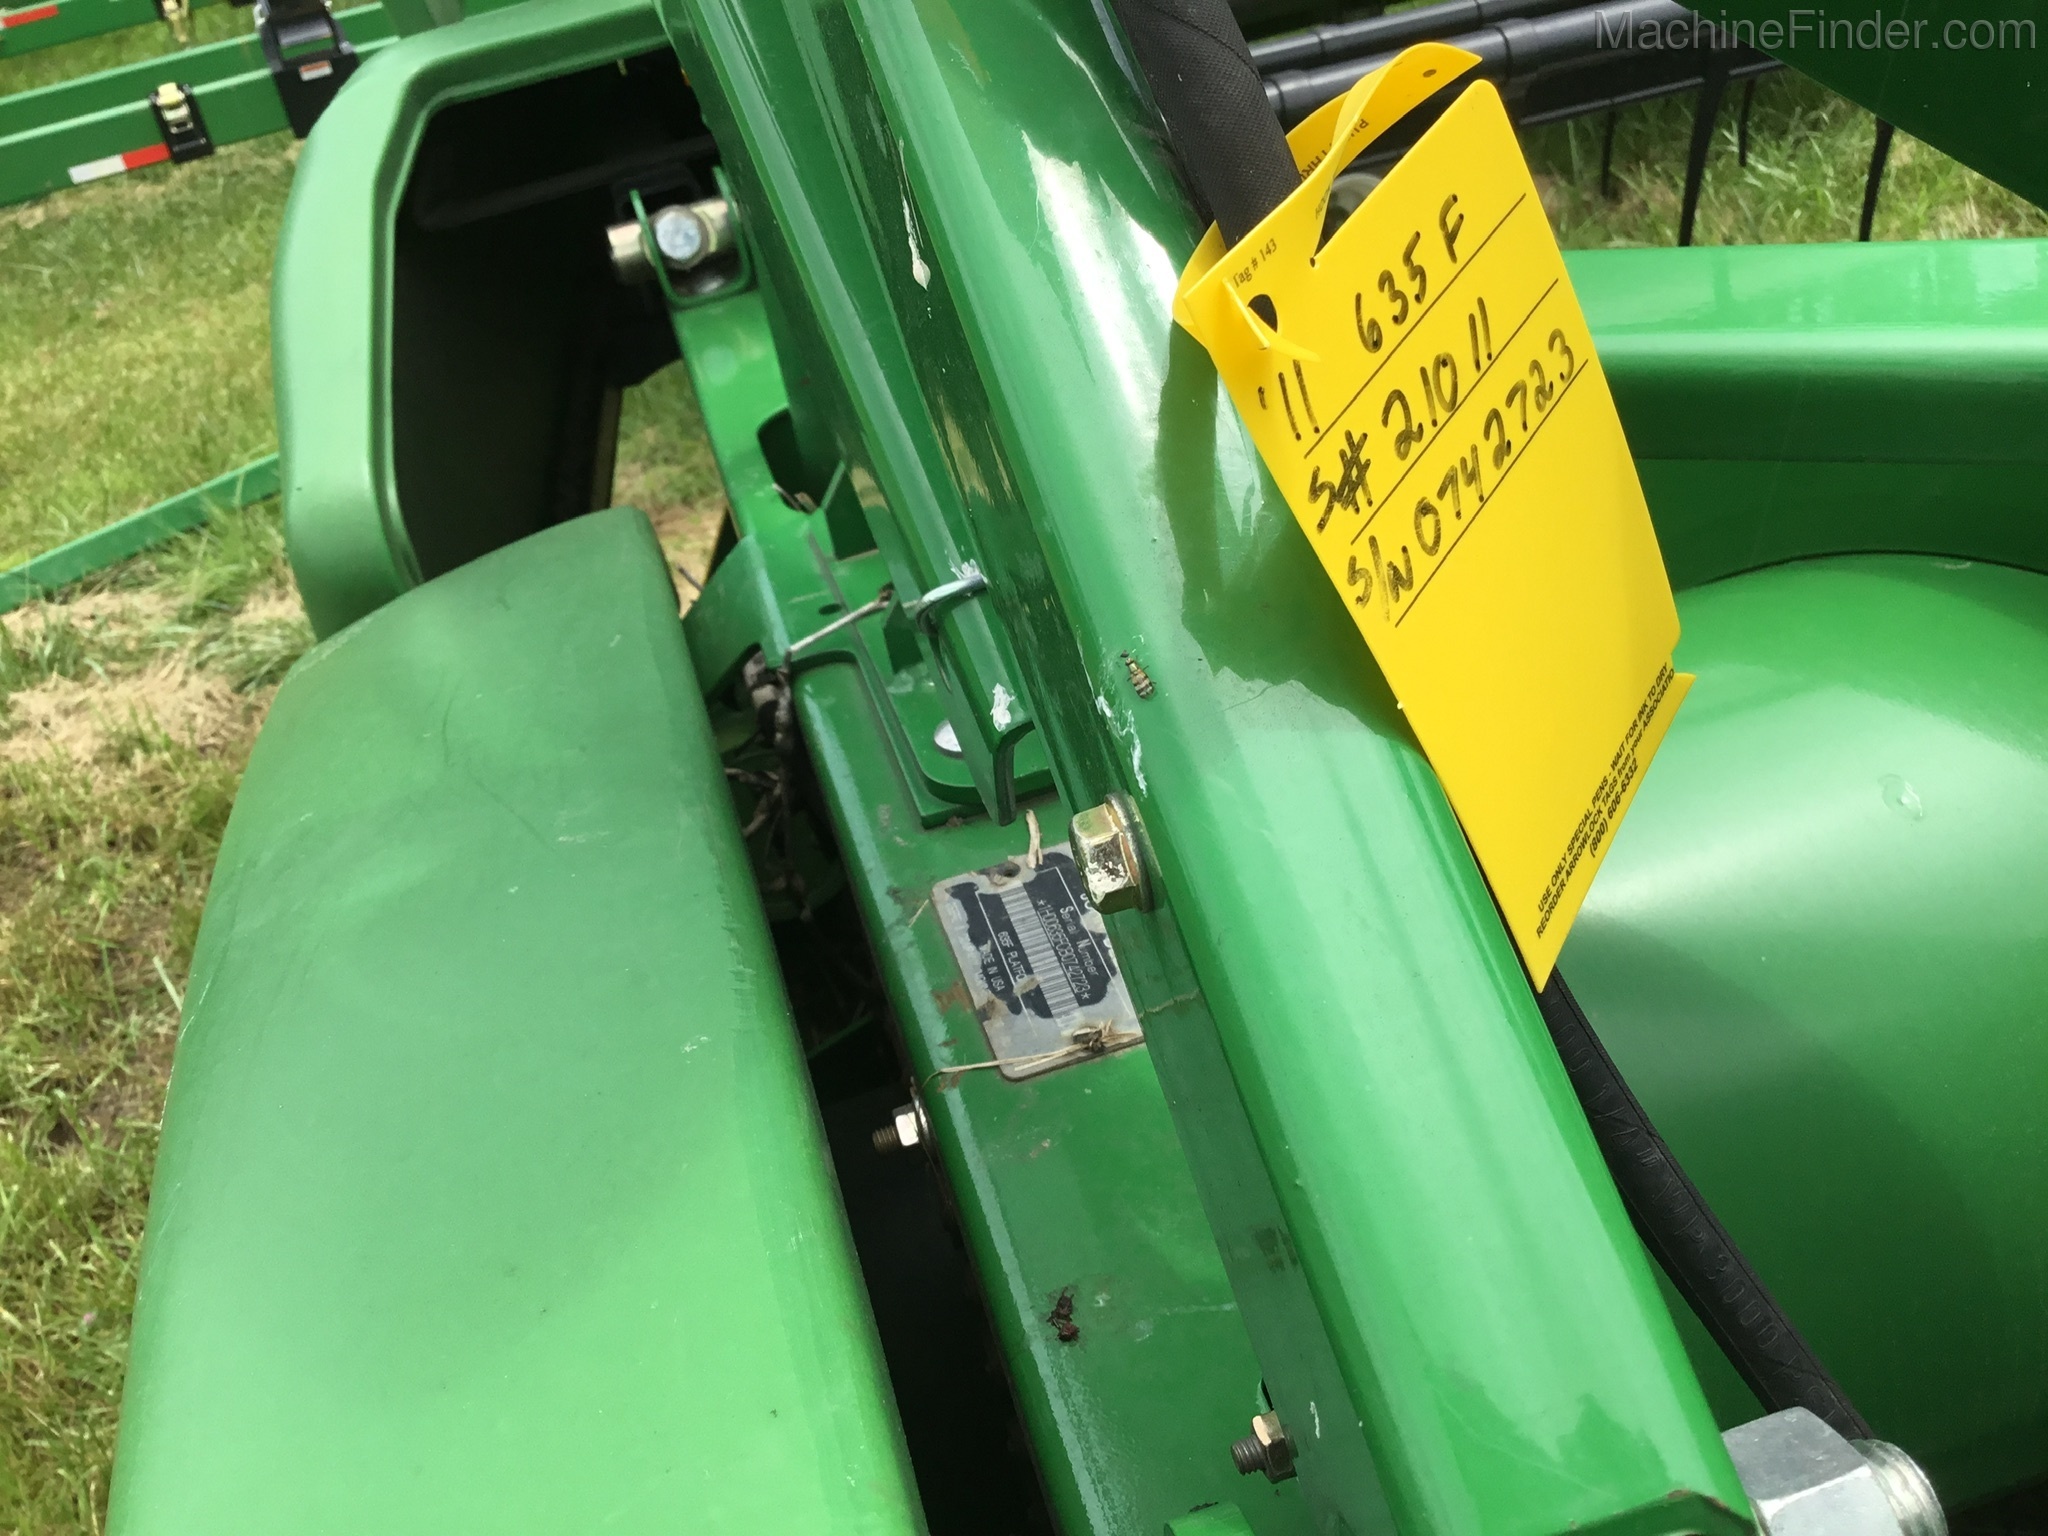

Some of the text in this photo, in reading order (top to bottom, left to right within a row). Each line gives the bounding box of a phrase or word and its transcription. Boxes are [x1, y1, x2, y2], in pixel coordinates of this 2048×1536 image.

[1232, 266, 1253, 288] Tag
[1259, 238, 1277, 261] 143
[1537, 668, 1675, 938] REORDER ARROWLOCK TAGS from your ASSOCIATIO
[1538, 885, 1552, 912] USE
[1551, 853, 1567, 887] ONLY
[1566, 807, 1593, 857] SPECIAL
[1592, 776, 1608, 808] PENS
[1611, 741, 1628, 771] WAIT
[1625, 719, 1640, 745] FOR
[1637, 700, 1648, 722] INK
[1647, 685, 1658, 701] TO
[1656, 663, 1667, 687] DRY
[1590, 758, 1638, 857] (800) 606-6332
[1006, 950, 1027, 982] PLATFO
[1060, 905, 1098, 975] Serial Number
[990, 975, 1005, 992] USA
